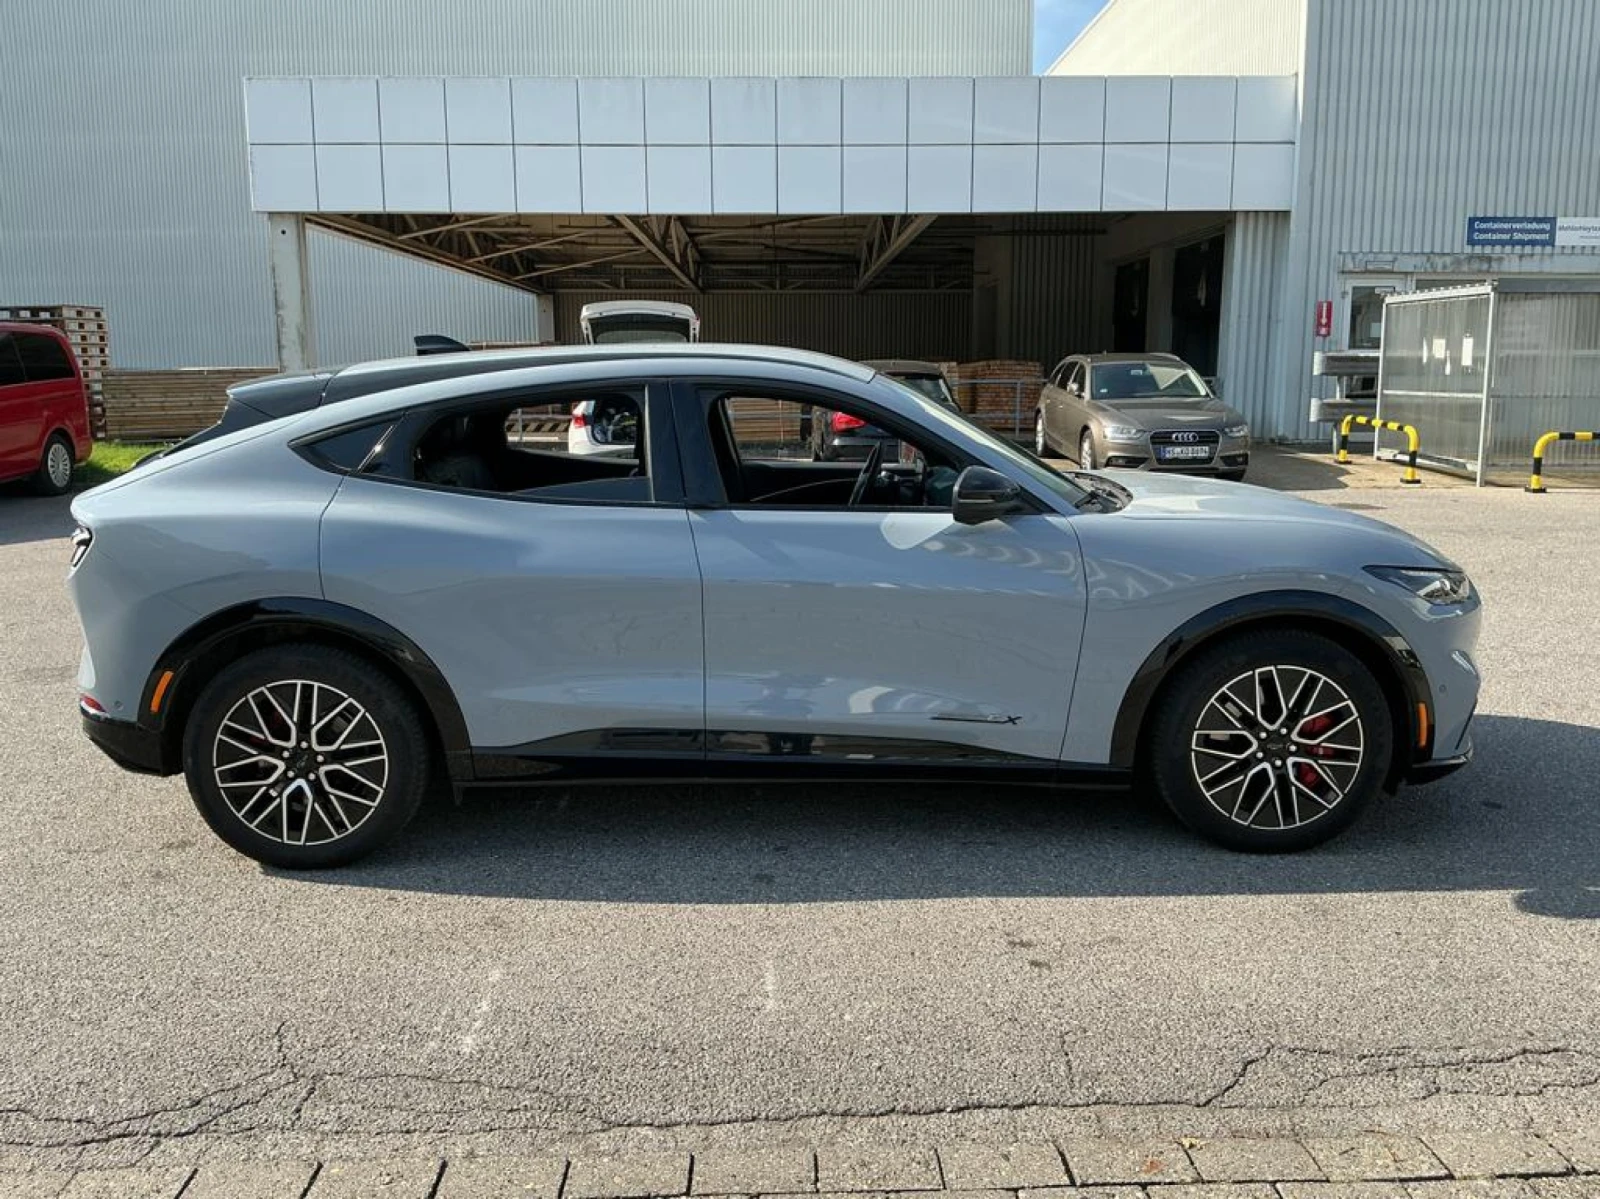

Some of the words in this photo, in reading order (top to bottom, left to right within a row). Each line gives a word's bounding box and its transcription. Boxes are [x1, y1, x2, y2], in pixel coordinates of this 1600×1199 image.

[1475, 221, 1550, 230] Containerverladung
[1474, 232, 1511, 240] Container
[1513, 232, 1549, 241] Shipment
